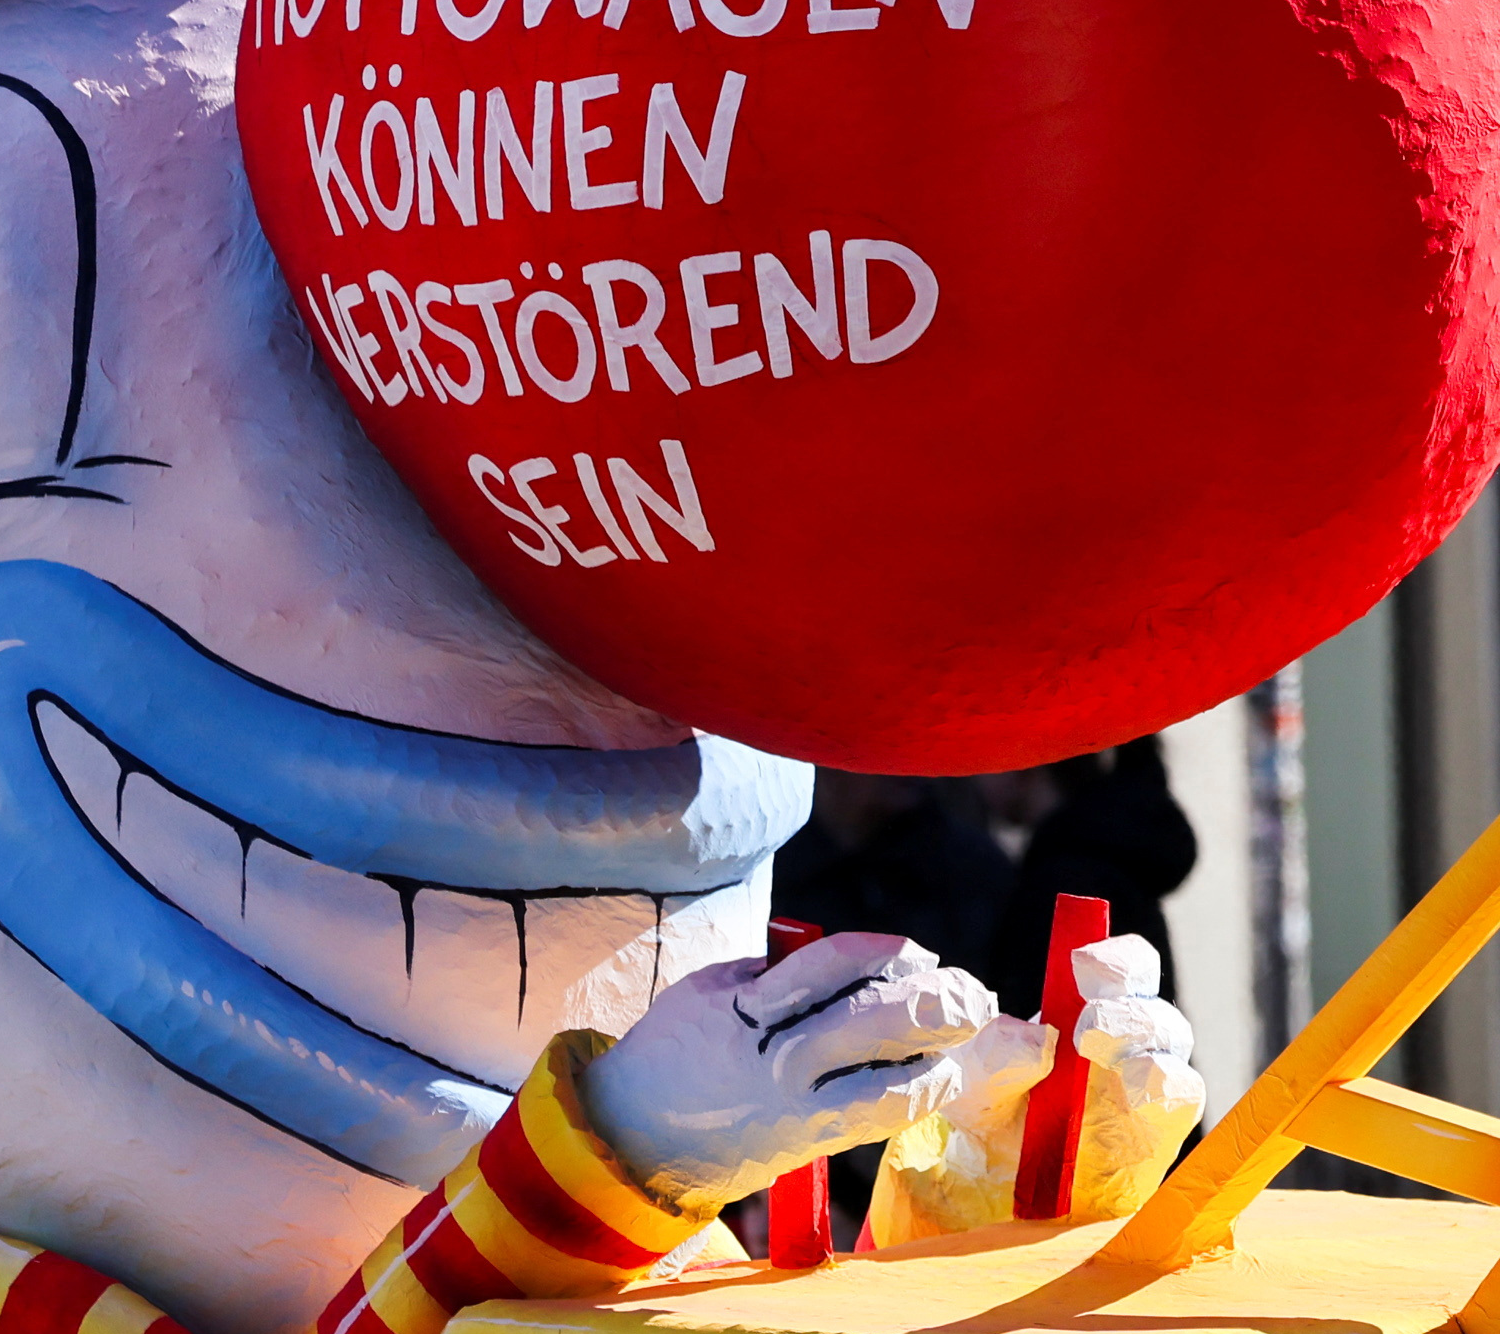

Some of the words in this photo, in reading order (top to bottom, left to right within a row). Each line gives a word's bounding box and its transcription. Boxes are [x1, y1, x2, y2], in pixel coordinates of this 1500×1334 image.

[303, 64, 747, 236] KÖNNEN
[305, 229, 939, 407] VERSTÖREND
[467, 440, 716, 568] SEIN
